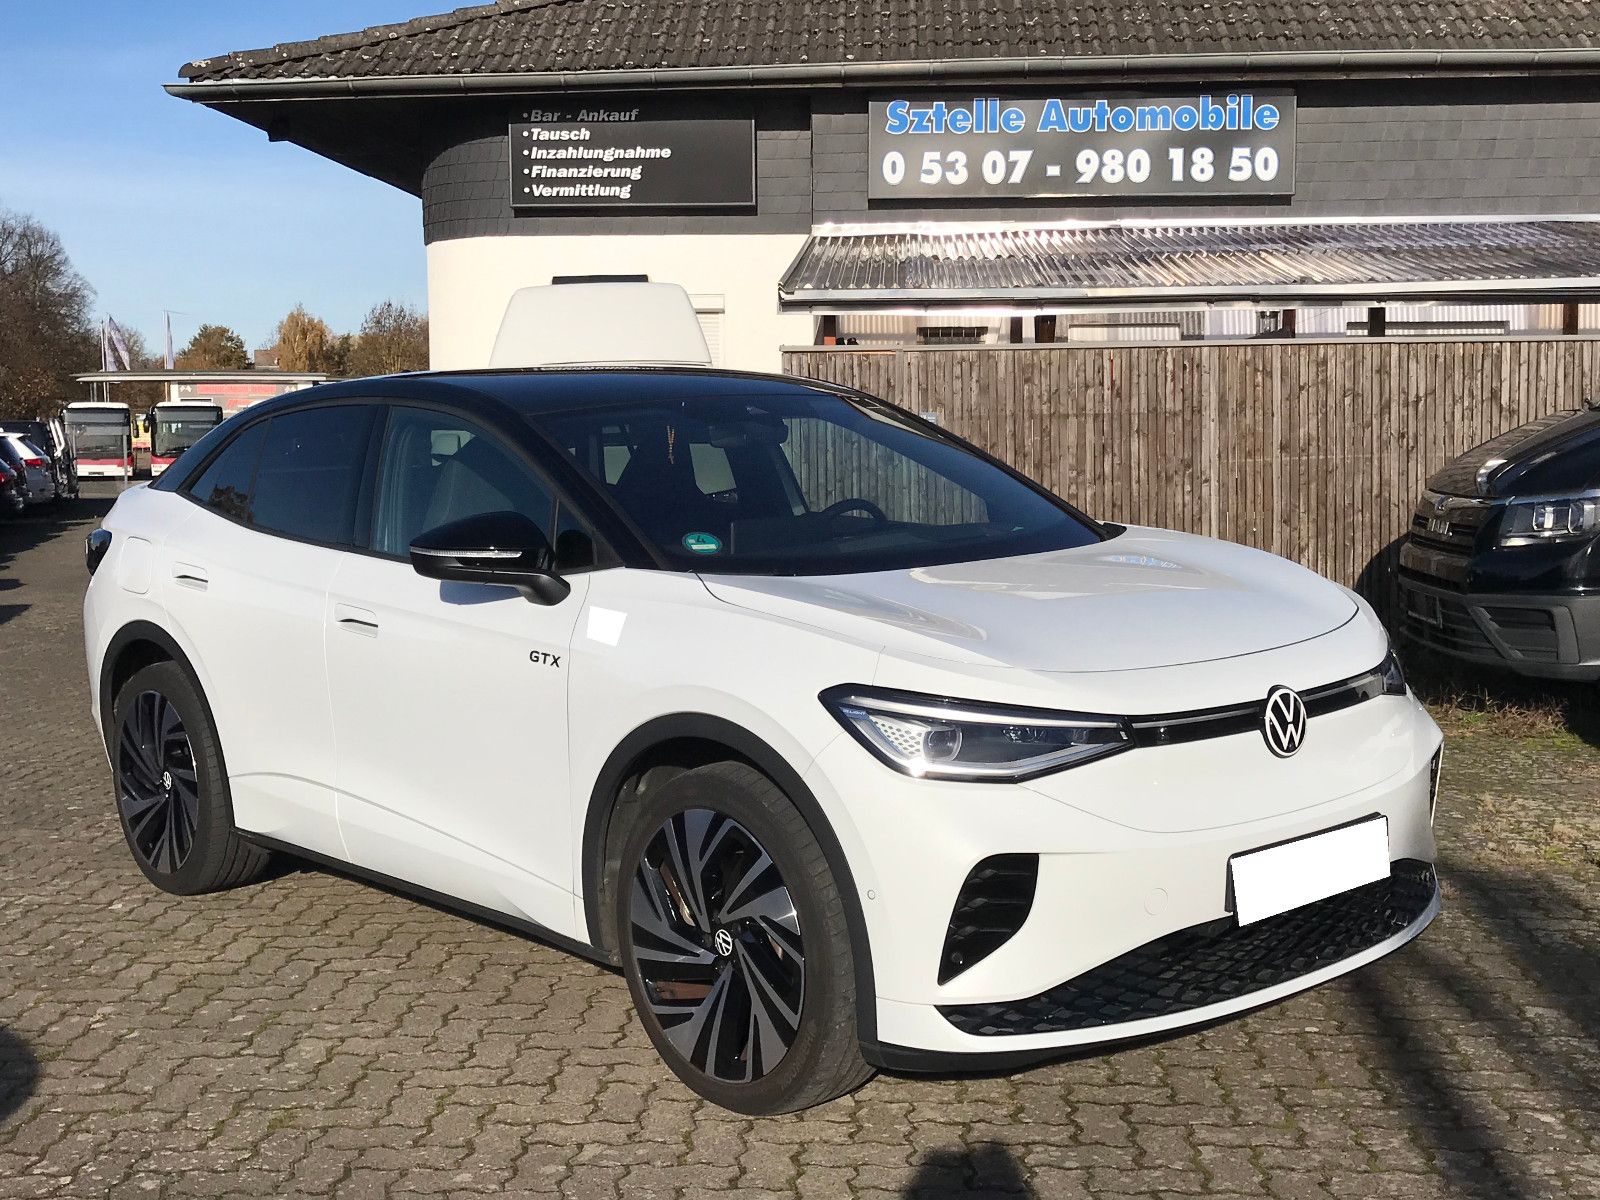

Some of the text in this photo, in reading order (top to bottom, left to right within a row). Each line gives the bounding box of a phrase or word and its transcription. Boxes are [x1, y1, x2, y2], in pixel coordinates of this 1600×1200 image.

[530, 110, 560, 122] Bar
[577, 108, 640, 122] Ankauf
[885, 94, 1281, 135] Sztelle Automobile
[531, 127, 591, 141] Tausch
[531, 146, 672, 162] Inzahlungnahme
[531, 165, 643, 181] Finanzierung
[881, 150, 906, 186] 0
[919, 150, 970, 185] 53
[981, 149, 1034, 185] 07
[1075, 148, 1152, 184] 980
[1168, 147, 1215, 182] 18
[1228, 146, 1279, 182] 50
[532, 184, 632, 199] Vermittlung
[529, 650, 561, 668] GTX
[1265, 688, 1304, 756] VW
